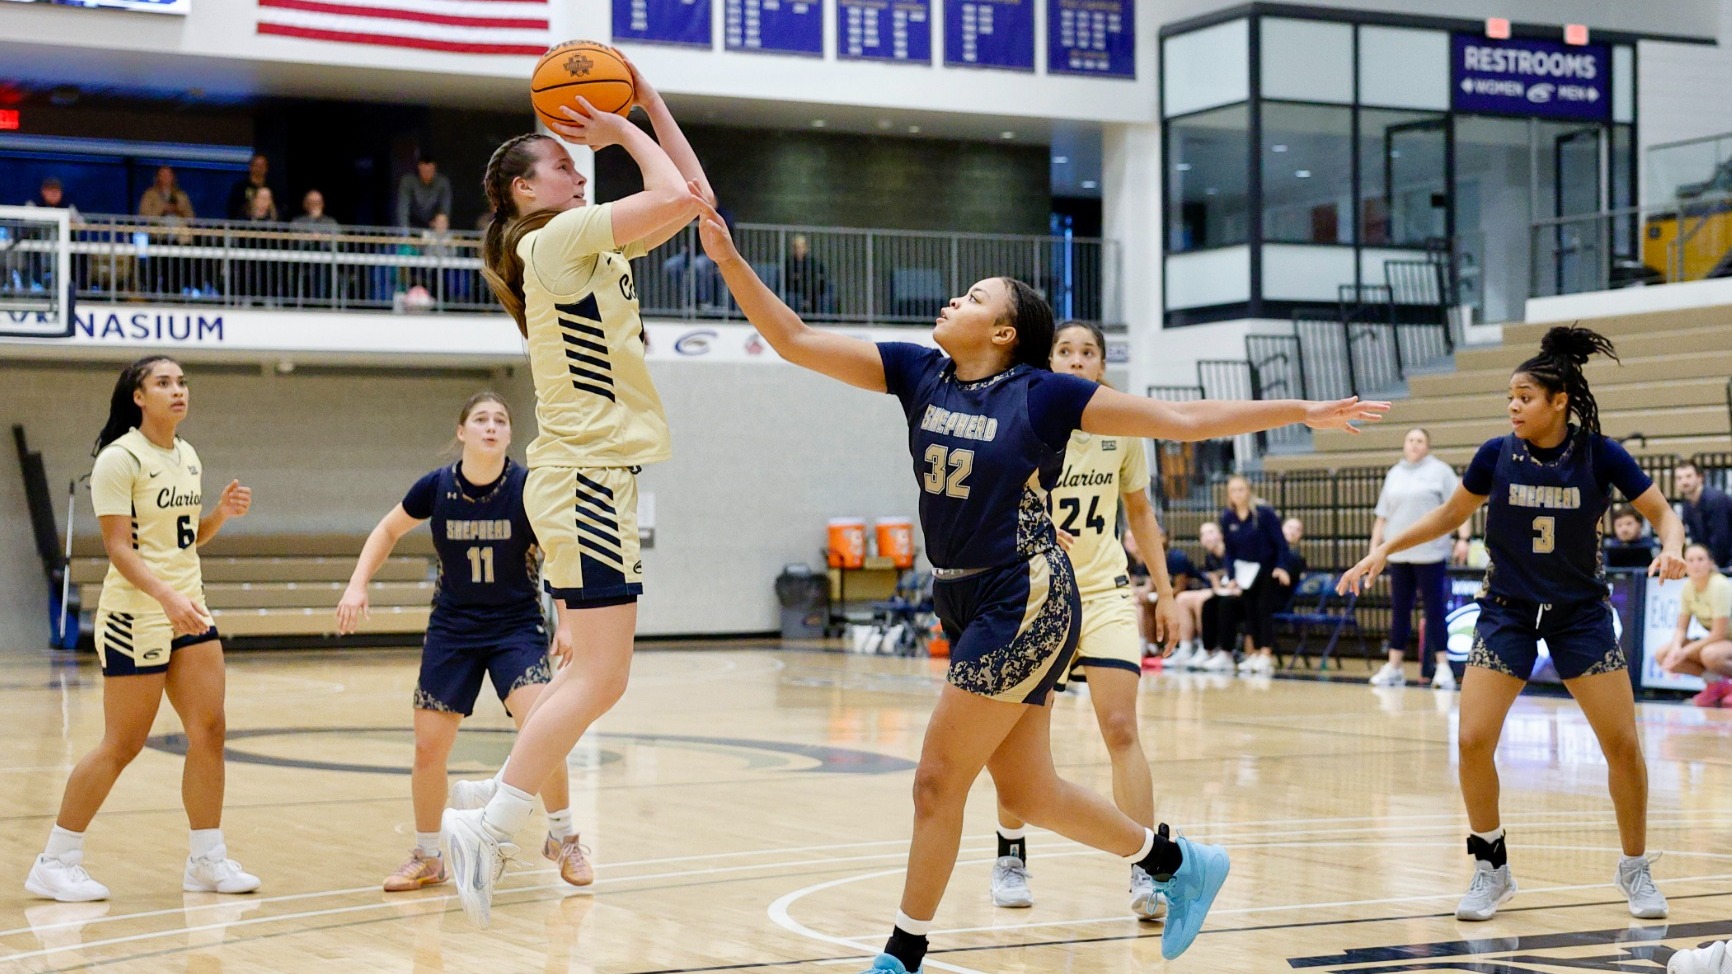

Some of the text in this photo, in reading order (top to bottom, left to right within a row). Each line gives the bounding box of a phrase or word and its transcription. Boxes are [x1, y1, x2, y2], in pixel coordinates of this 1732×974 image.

[1464, 45, 1597, 79] RESTROOMS
[1474, 79, 1587, 101] WOMEN MEN
[921, 403, 998, 442] SHEPHERD
[923, 443, 975, 500] 32
[1056, 465, 1114, 488] larion
[157, 486, 201, 509] Clario
[1508, 483, 1580, 509] SHEPHERD
[177, 515, 195, 549] 6
[446, 519, 512, 540] SHEPHERD
[1059, 496, 1105, 537] 24
[1532, 516, 1555, 553] 3
[466, 546, 494, 583] 11
